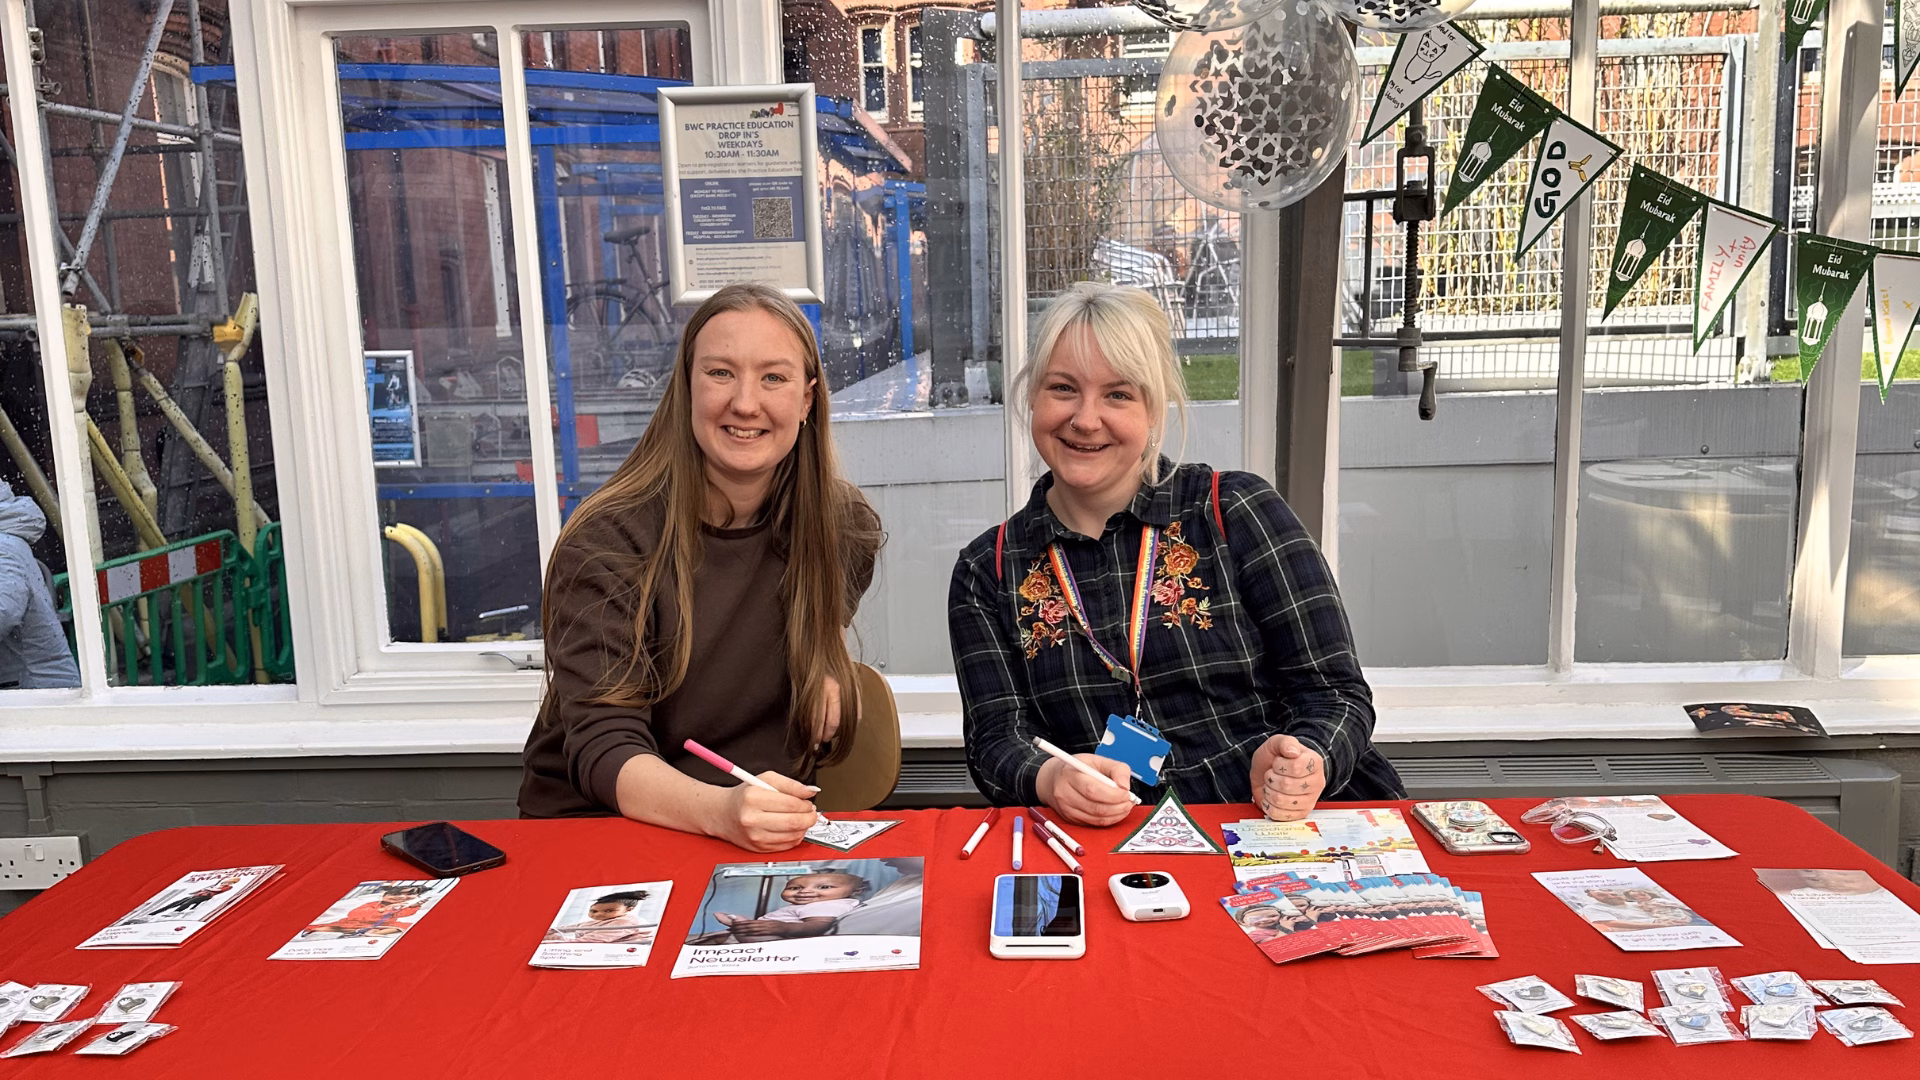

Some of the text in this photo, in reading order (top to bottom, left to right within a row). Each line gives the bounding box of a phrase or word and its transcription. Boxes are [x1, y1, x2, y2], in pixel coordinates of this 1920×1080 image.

[1509, 98, 1525, 113] Eid
[1490, 102, 1526, 132] Mubarak
[685, 121, 794, 131] BWC PRACTICE EDUCATION
[719, 132, 741, 140] DROP
[718, 140, 763, 149] WEEKDAYS
[1534, 141, 1567, 218] GOD
[1656, 192, 1673, 206] Eid
[1640, 199, 1677, 224] Mubarak
[1827, 253, 1843, 265] Eid
[1700, 245, 1731, 312] FAMILY
[1812, 263, 1850, 280] Mubarak
[1135, 588, 1149, 634] supporting
[693, 947, 763, 956] Impact
[690, 955, 799, 964] Newsletter
